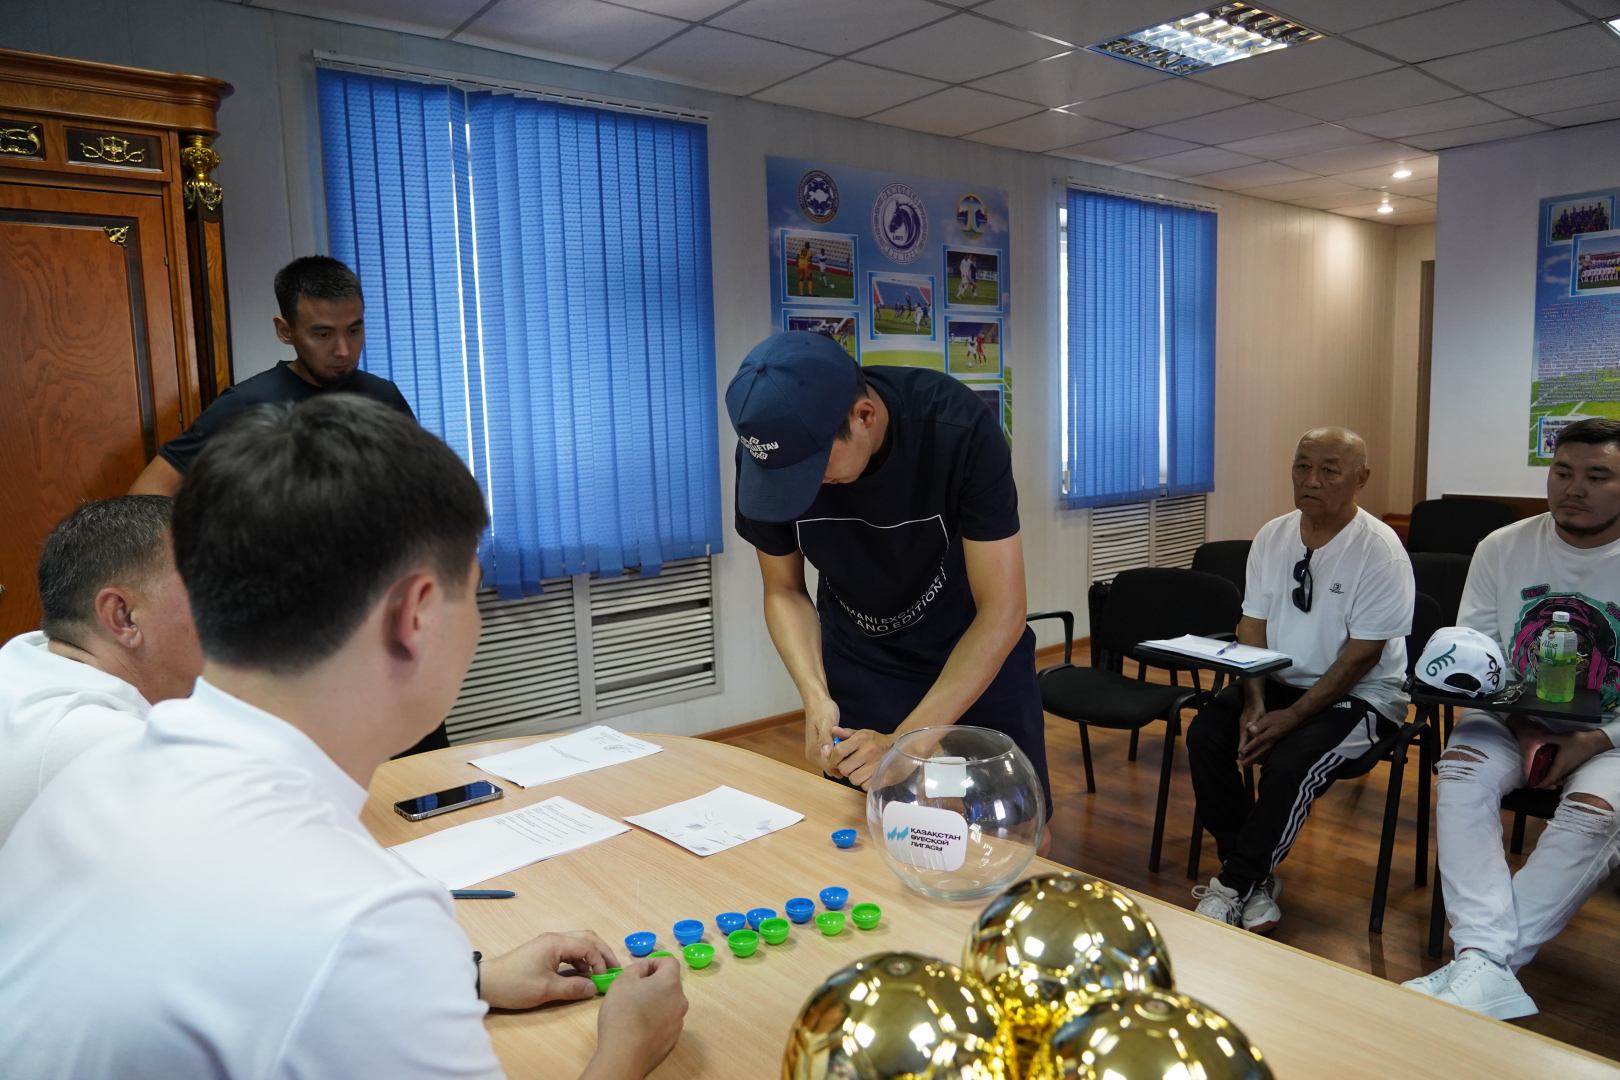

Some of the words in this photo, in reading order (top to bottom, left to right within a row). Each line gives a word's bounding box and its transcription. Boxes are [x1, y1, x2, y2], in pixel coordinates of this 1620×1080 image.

[1523, 586, 1548, 599] KEEP
[892, 581, 943, 623] EDITION
[1541, 639, 1558, 650] Aloe
[910, 827, 961, 841] ҚАЗАҚСТАН
[910, 841, 943, 852] ЛИГАСЫ
